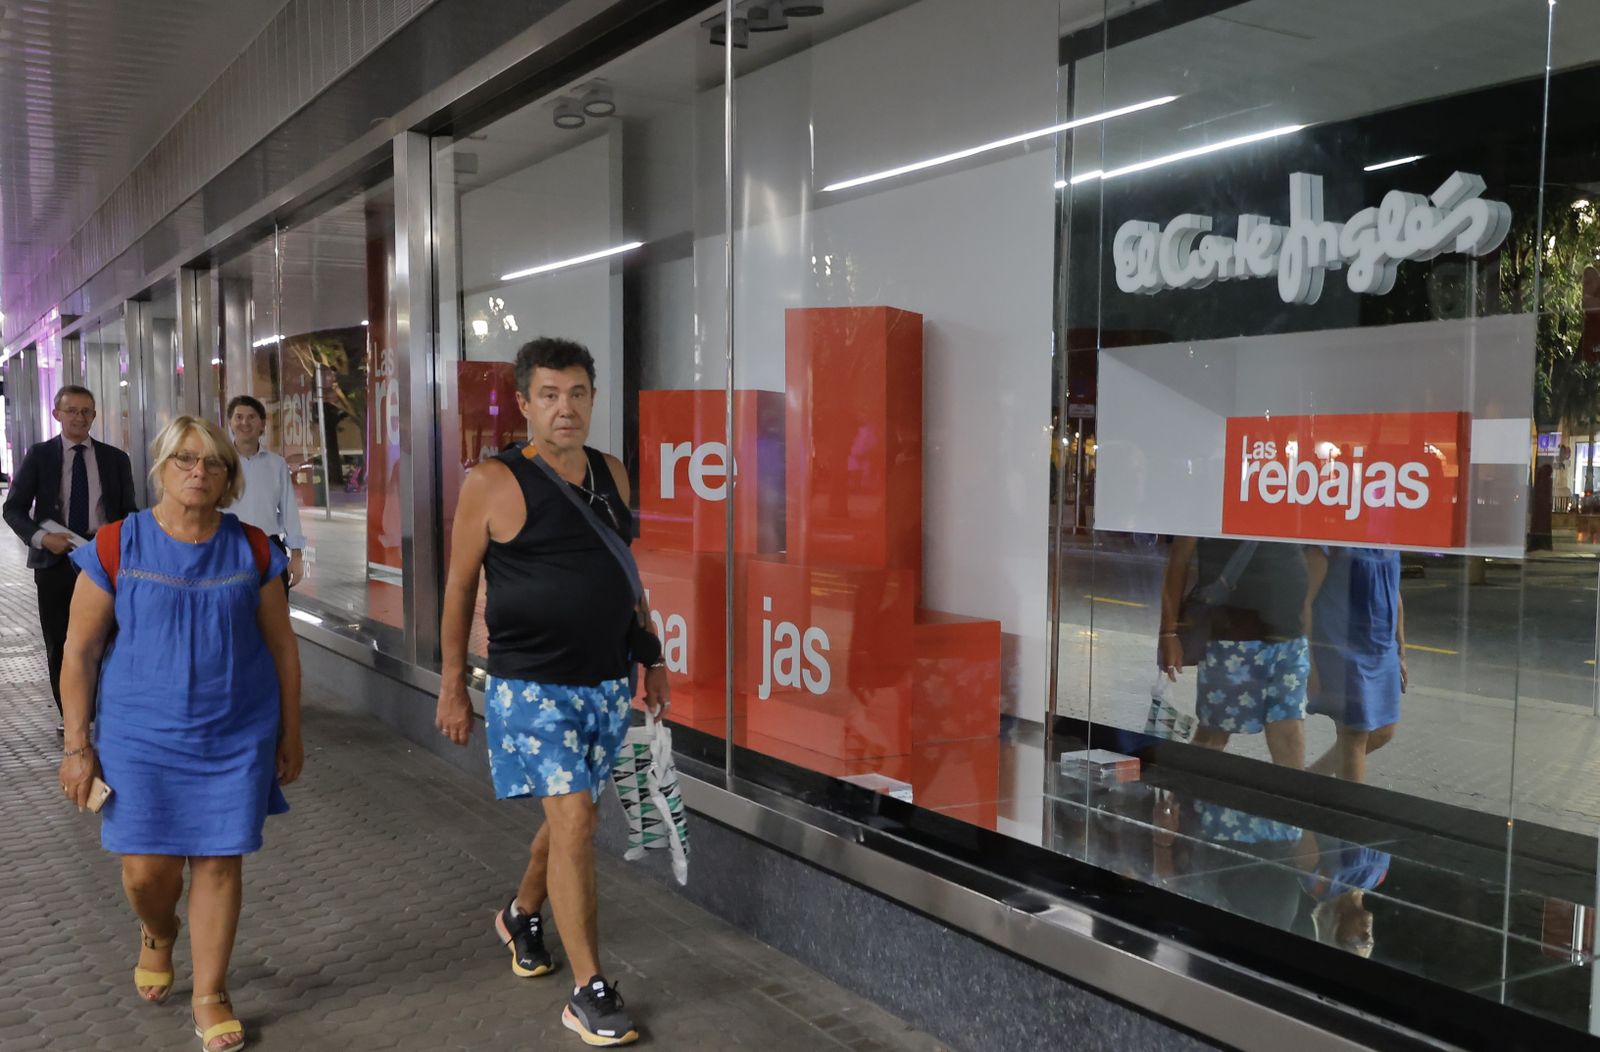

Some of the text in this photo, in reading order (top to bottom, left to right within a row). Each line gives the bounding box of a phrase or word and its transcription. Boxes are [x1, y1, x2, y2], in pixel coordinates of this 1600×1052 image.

[1113, 219, 1162, 295] El
[1159, 213, 1289, 290] Corte
[660, 441, 738, 501] re
[1240, 441, 1430, 520] rebajas
[1242, 435, 1277, 460] Las
[758, 596, 831, 700] jas
